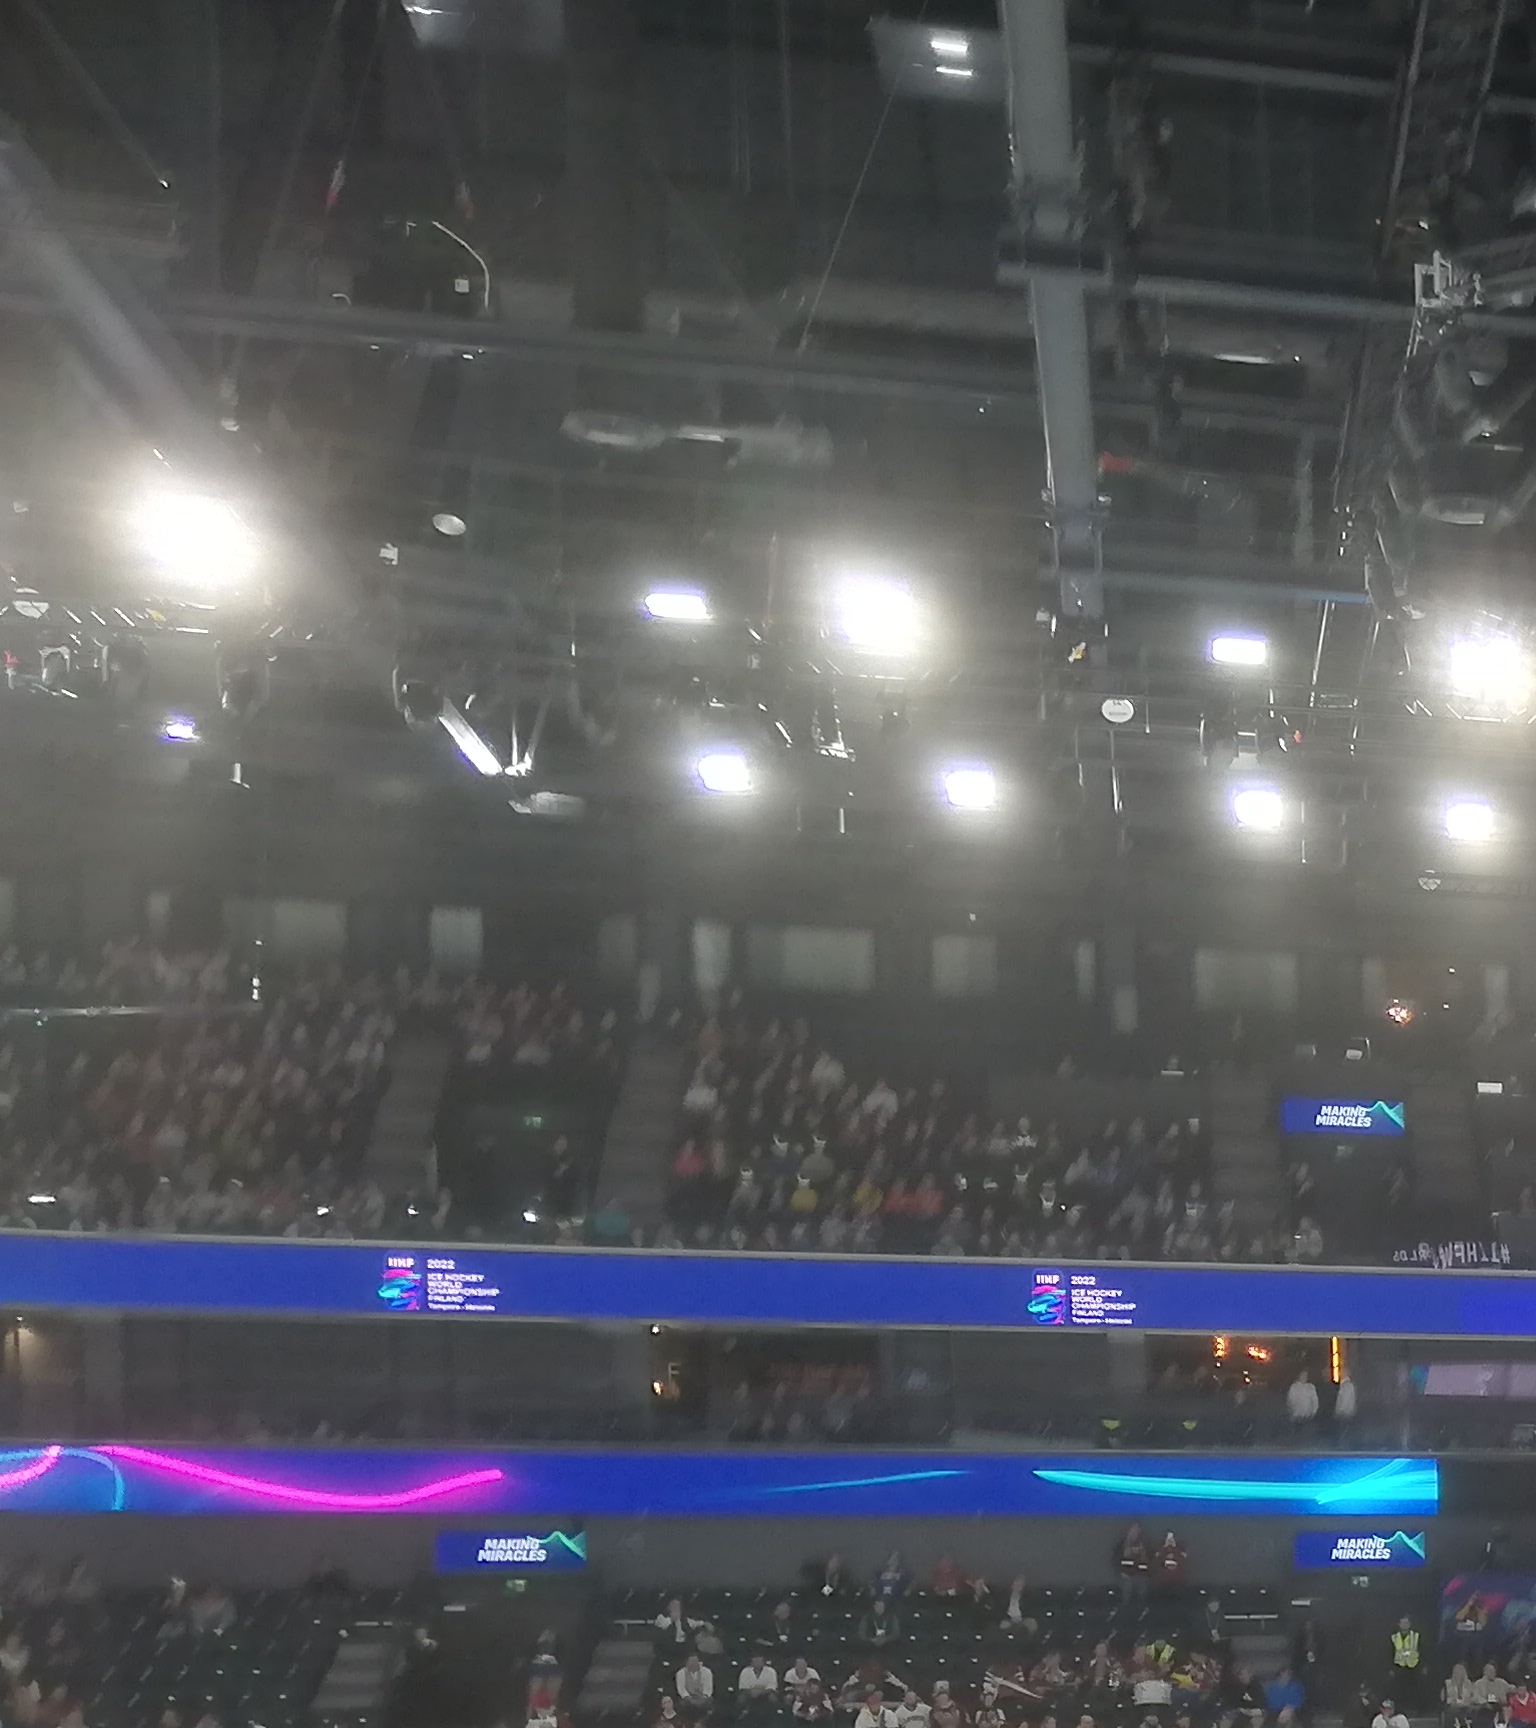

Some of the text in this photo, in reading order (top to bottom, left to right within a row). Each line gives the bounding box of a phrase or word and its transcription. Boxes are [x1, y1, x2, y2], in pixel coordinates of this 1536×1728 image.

[1320, 1105, 1366, 1117] MAKING
[1315, 1115, 1372, 1127] MIRACLES
[484, 1538, 541, 1550] MAKING
[1336, 1538, 1385, 1549] MAKING
[477, 1549, 547, 1561] MIRACLES
[1331, 1548, 1390, 1560] MIRACLES
